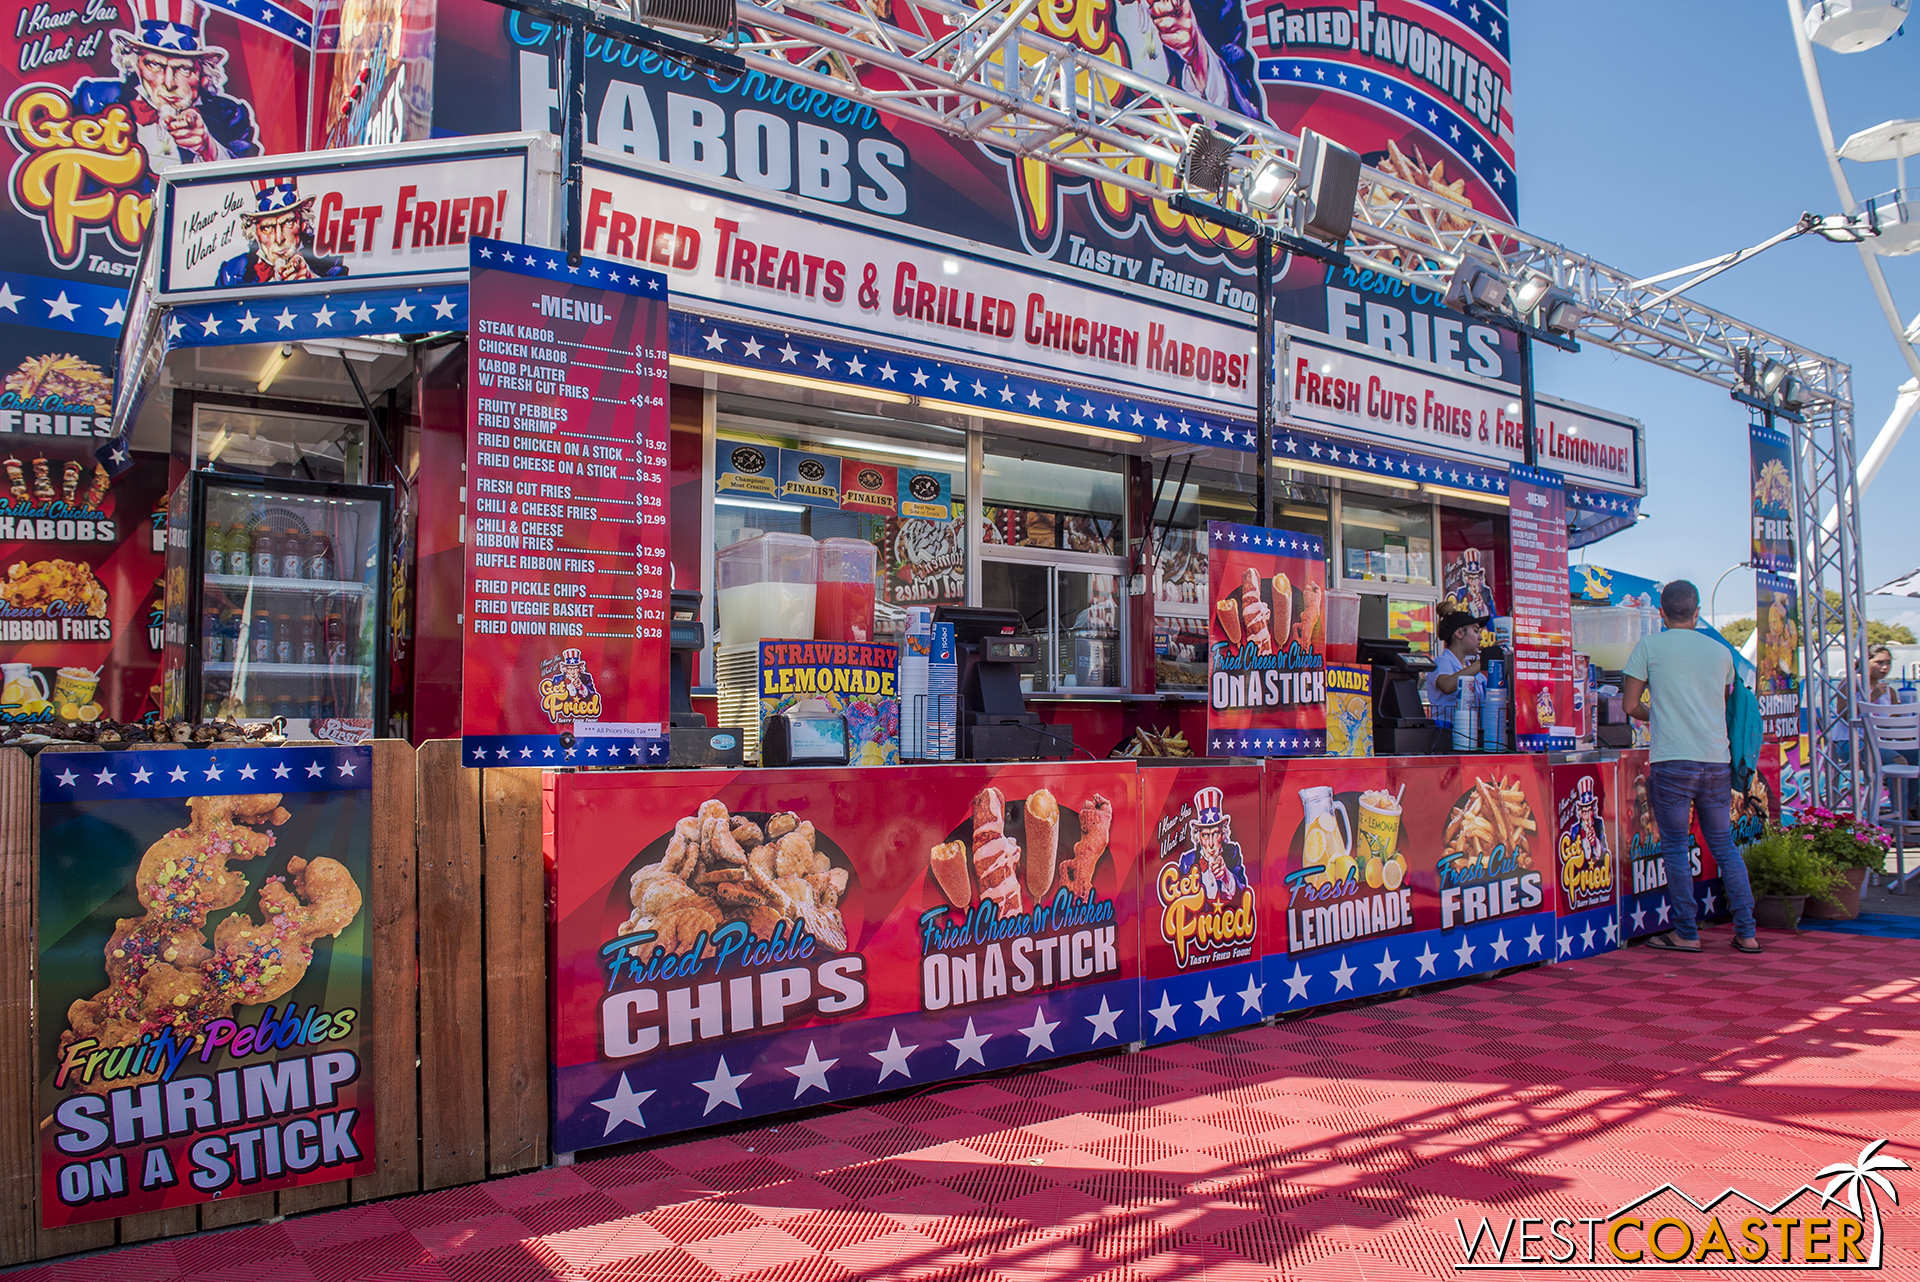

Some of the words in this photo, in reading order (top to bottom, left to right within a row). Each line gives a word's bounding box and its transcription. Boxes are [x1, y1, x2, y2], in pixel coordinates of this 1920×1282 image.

[27, 8, 77, 32] Know
[82, 0, 118, 22] You
[20, 38, 74, 71] Want
[76, 30, 104, 58] it!
[1269, 9, 1350, 46] FRIED
[1360, 1, 1503, 133] FAVORITES!
[17, 93, 131, 153] Get
[188, 206, 219, 240] Know
[223, 191, 245, 219] You
[314, 191, 382, 256] GET
[392, 185, 508, 249] FRIED!
[187, 240, 218, 270] Want
[220, 219, 235, 251] it!
[1069, 234, 1142, 282] TASTY
[1149, 259, 1208, 300] FRIED
[583, 188, 700, 271] FRIED
[714, 216, 846, 303] TREATS
[858, 262, 880, 310] &
[893, 261, 1014, 338] GRILLED
[1024, 293, 1138, 366] CHICKEN
[1147, 321, 1250, 389] KABOBS!
[479, 319, 514, 337] STEAK
[518, 326, 555, 343] KABOB
[1327, 286, 1503, 378] FRIES
[479, 339, 527, 358] CHICKEN
[531, 346, 567, 364] KABOB
[479, 358, 516, 375] KABOB
[520, 364, 565, 382] PLATTER
[479, 372, 493, 387] W/
[497, 375, 532, 392] FRESH
[536, 380, 556, 395] CUT
[559, 383, 589, 400] FRIES
[0, 392, 40, 411] Chili
[43, 394, 95, 413] Cheese
[478, 398, 516, 415] FRUITY
[519, 403, 568, 421] PEBBLES
[1295, 357, 1361, 416] FRESH
[1367, 375, 1417, 427] CUTS
[1424, 388, 1472, 437] FRIES
[1478, 418, 1489, 450] &
[1495, 409, 1544, 458] FREH
[1549, 421, 1629, 475] LEMONADE!
[478, 413, 510, 429] FRIED
[513, 417, 557, 434] SHRIMP
[478, 432, 510, 448] FRIED
[513, 436, 561, 454] CHICKEN
[564, 442, 579, 456] ON
[582, 445, 590, 457] A
[592, 446, 622, 461] STICK
[477, 452, 510, 468] FRIED
[513, 456, 555, 473] CHEESE
[558, 461, 574, 474] ON
[576, 463, 584, 476] A
[587, 464, 617, 479] STICK
[477, 478, 513, 494] FRESH
[516, 482, 538, 496] CUT
[541, 484, 571, 499] FRIES
[735, 476, 765, 484] Champion!
[746, 483, 770, 491] Creative
[787, 482, 836, 497] FINALIST
[50, 501, 105, 519] Chicken
[477, 498, 506, 513] CHILI
[509, 501, 518, 514] &
[522, 502, 564, 518] CHEESE
[567, 506, 597, 521] FRIES
[847, 492, 893, 506] FINALIST
[476, 518, 506, 533] CHILI
[509, 521, 518, 534] &
[521, 521, 564, 537] CHEESE
[1753, 517, 1796, 541] FRIES
[476, 533, 519, 549] RIBBON
[523, 536, 554, 551] FRIES
[475, 553, 516, 568] RUFFLE
[520, 555, 562, 571] RIBBON
[565, 558, 595, 573] FRIES
[475, 579, 508, 594] FRIED
[511, 581, 550, 596] PICKLE
[554, 584, 586, 598] CHIPS
[47, 599, 87, 617] Chili
[475, 600, 507, 614] FRIED
[511, 602, 550, 615] VEGGIE
[553, 603, 594, 617] BASKET
[63, 618, 110, 640] FRIES
[474, 620, 507, 634] FRIED
[510, 621, 546, 635] ONION
[549, 622, 583, 636] RINGS
[940, 627, 948, 648] pepsi
[764, 643, 898, 670] STRAWBERRY
[1212, 642, 1243, 671] Fried
[1243, 641, 1277, 670] Cheese
[1288, 641, 1323, 668] Chicken
[541, 681, 565, 693] Get
[764, 667, 895, 696] LEMONADE
[1248, 671, 1263, 706] A
[1265, 669, 1325, 706] STICK
[544, 692, 599, 719] Fried
[1759, 693, 1798, 716] SHRIMP
[1776, 716, 1799, 737] STICK
[1561, 834, 1581, 858] Get
[1438, 853, 1483, 889] Fresh
[1488, 844, 1519, 875] Cut
[1564, 851, 1611, 903] Fried
[1162, 866, 1199, 901] Get
[1285, 866, 1358, 907] Fresh
[1442, 873, 1541, 929] FRIES
[921, 907, 971, 954] Fried
[974, 900, 1030, 945] Cheese
[1051, 887, 1113, 931] Chicken
[1165, 887, 1253, 959] Fried
[1288, 888, 1412, 953] LEMONADE
[602, 933, 706, 992] Fried
[712, 920, 815, 974] Pickle
[983, 943, 1008, 999] A
[1011, 926, 1117, 993] STICK
[1190, 953, 1211, 966] TASTY
[1212, 950, 1231, 963] FRIED
[602, 957, 864, 1058] CHIPS
[55, 1027, 193, 1087] Fruity
[200, 1003, 356, 1063] Pebbles
[57, 1052, 356, 1152] SHRIMP
[60, 1157, 124, 1201] ON
[143, 1149, 173, 1186] A
[192, 1110, 359, 1188] STICK
